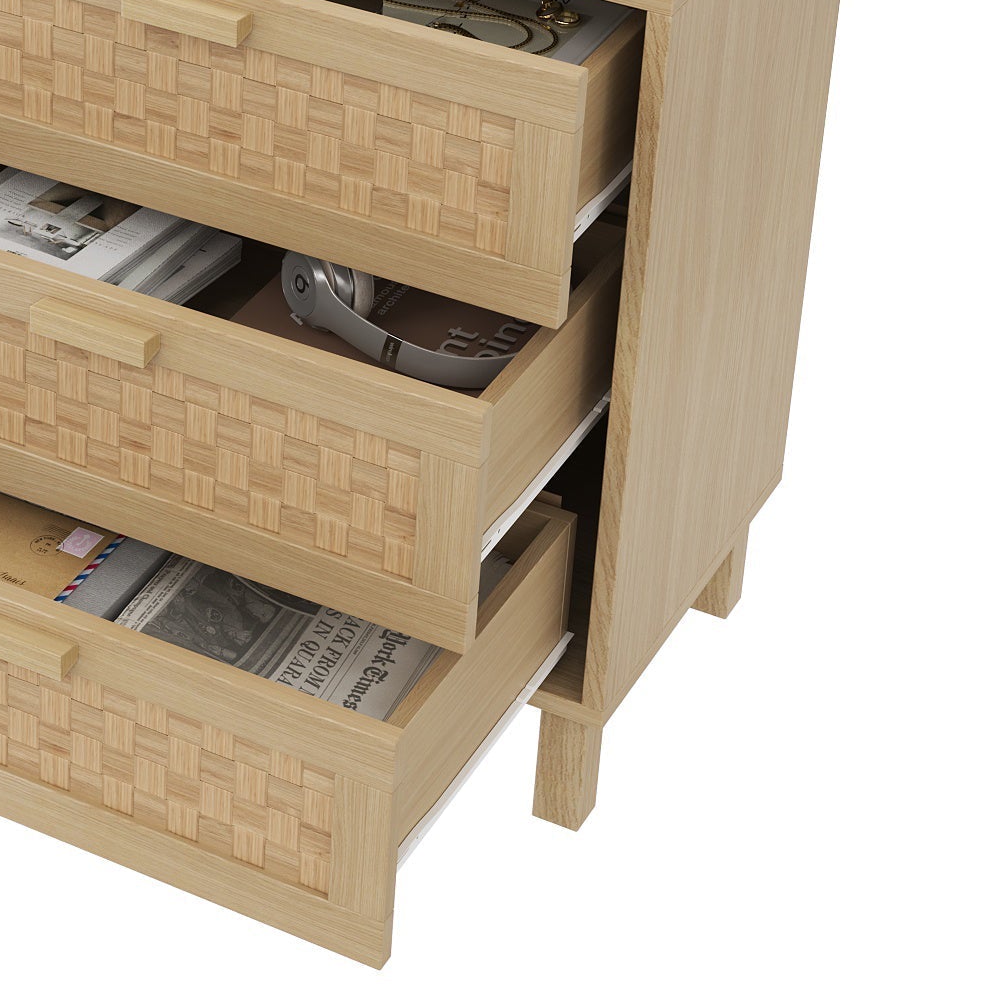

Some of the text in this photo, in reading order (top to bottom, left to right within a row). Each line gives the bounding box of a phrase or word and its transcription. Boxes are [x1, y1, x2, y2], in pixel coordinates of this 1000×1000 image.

[312, 619, 334, 640] IN
[331, 616, 363, 649] ACK
[304, 645, 343, 690] FROM
[342, 666, 389, 711] Times
